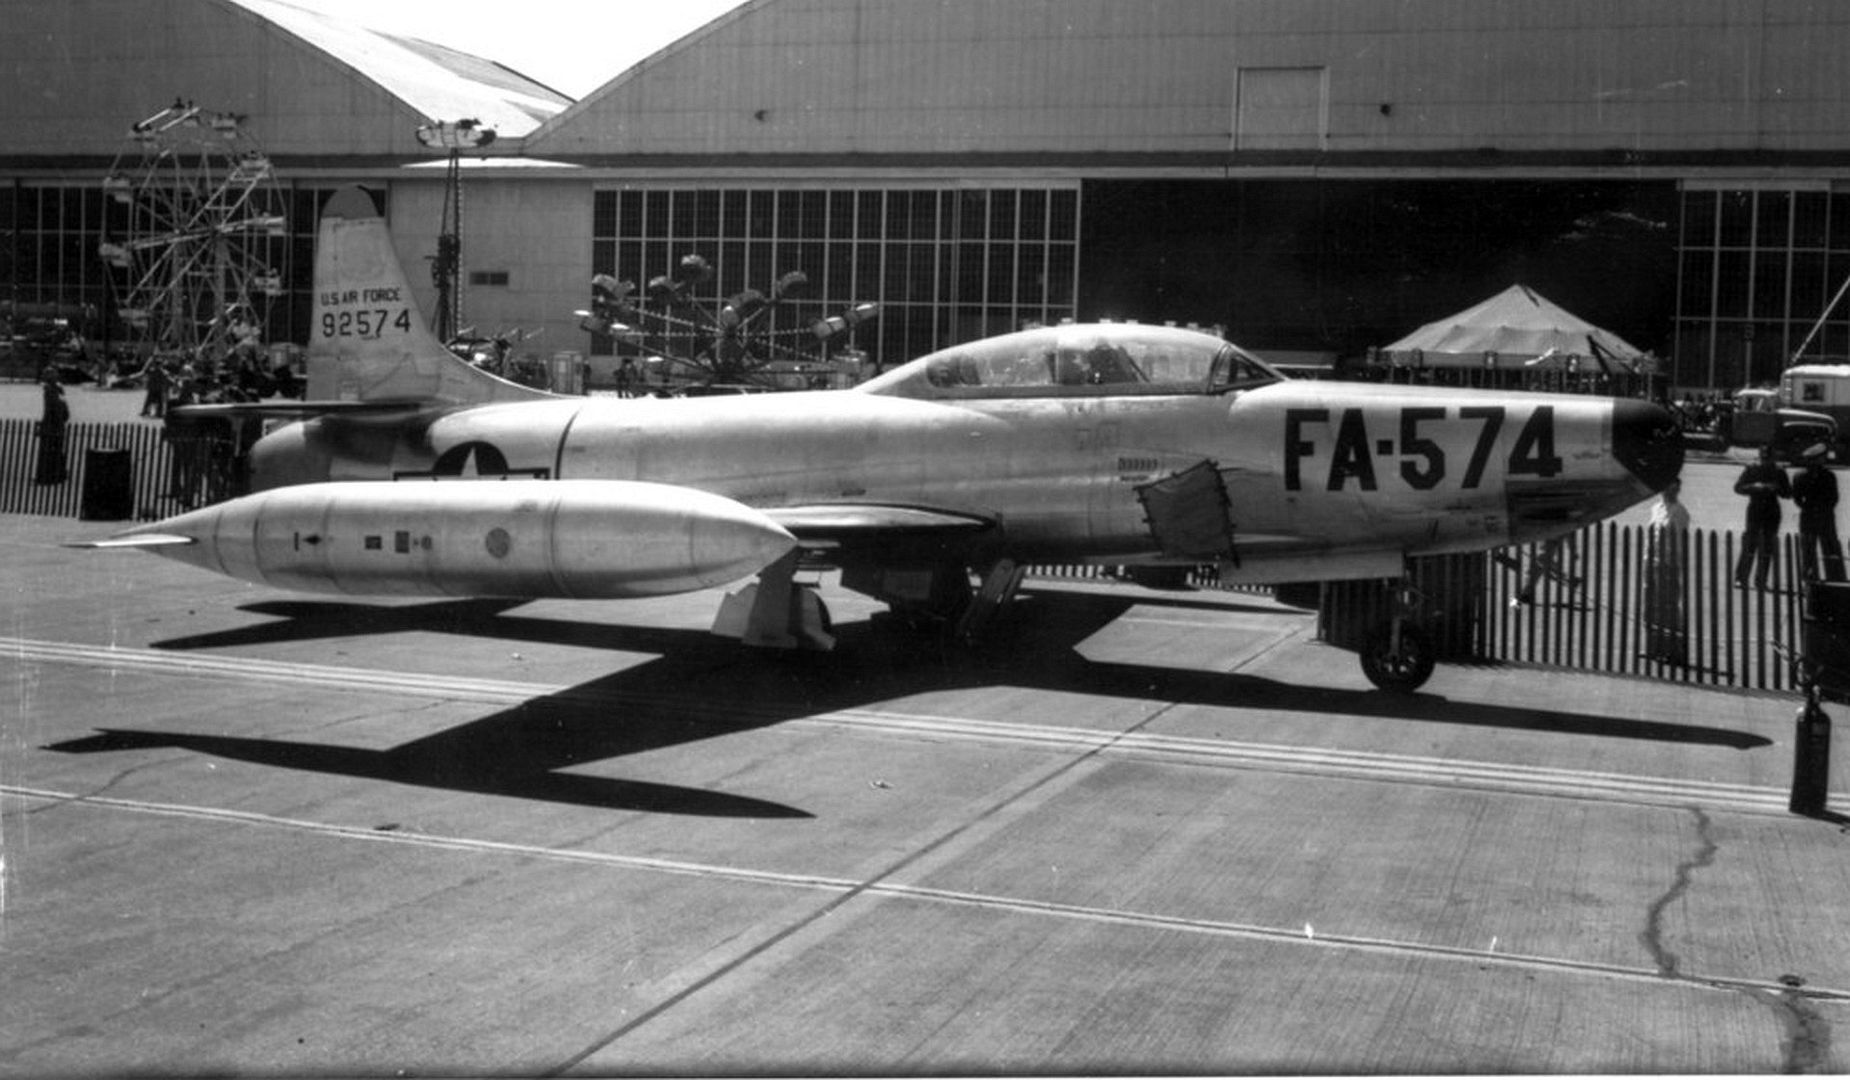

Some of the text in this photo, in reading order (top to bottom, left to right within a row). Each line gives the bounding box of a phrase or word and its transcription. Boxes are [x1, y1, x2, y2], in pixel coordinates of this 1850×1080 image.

[342, 290, 358, 304] AIR
[362, 287, 400, 303] FORCE
[322, 308, 411, 338] 92574
[1284, 405, 1562, 492] FA-574
